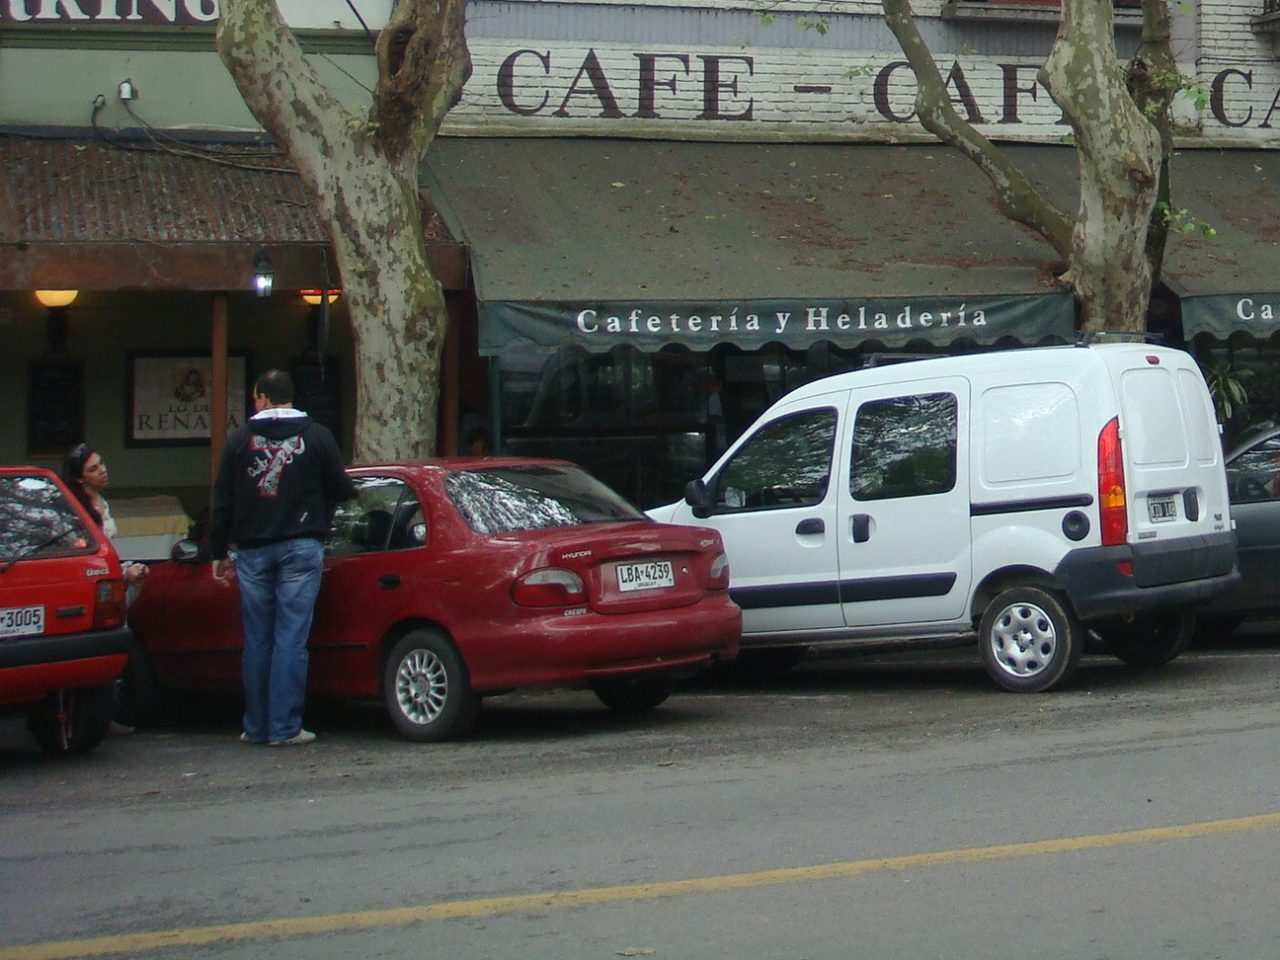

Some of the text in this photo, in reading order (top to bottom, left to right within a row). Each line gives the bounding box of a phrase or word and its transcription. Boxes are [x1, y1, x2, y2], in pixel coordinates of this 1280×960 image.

[497, 48, 753, 120] CAFE
[873, 59, 1072, 125] CAF
[577, 303, 988, 334] Cafetería y Heladería
[169, 403, 188, 412] LO
[138, 413, 239, 431] RENAA
